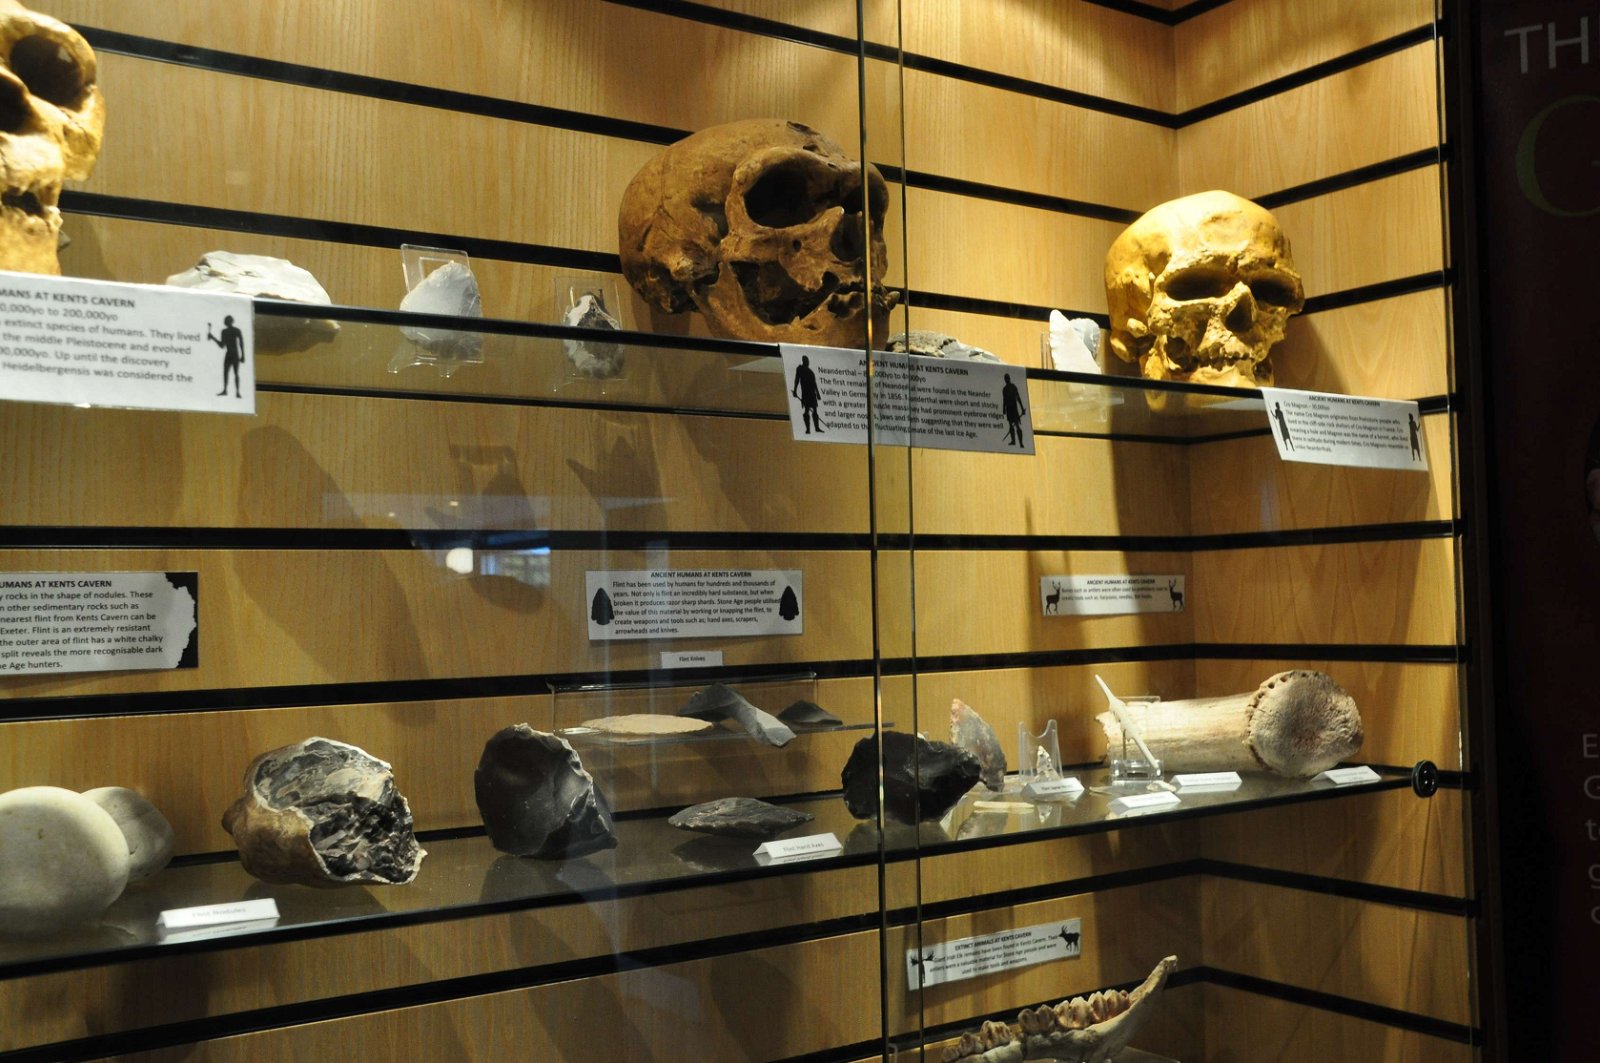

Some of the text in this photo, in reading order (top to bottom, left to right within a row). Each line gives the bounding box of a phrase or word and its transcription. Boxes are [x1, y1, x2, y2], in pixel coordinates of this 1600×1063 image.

[35, 292, 48, 301] AT
[53, 294, 88, 304] KENTS
[90, 297, 135, 308] CAVERN
[48, 306, 59, 315] to
[62, 308, 118, 322] 200,000yo
[4, 318, 200, 341] extinct species of humans. They lived
[2, 332, 191, 354] the middle Pleistocene and evolved
[54, 351, 70, 361] Up
[74, 353, 98, 361] until
[100, 354, 118, 363] the
[121, 355, 169, 368] discovery
[2, 361, 90, 375] Heidelbergensis
[116, 371, 173, 381] considered
[176, 374, 193, 382] the
[818, 367, 856, 376] Neanderthal
[944, 367, 969, 375] CAVERN
[820, 377, 832, 385] The
[832, 378, 845, 386] first
[821, 388, 840, 398] Valley
[56, 592, 81, 600] shape
[32, 603, 85, 612] sedimentary
[74, 625, 114, 634] extremely
[116, 624, 152, 632] resistant
[138, 635, 164, 644] chalky
[1, 650, 19, 659] split
[93, 647, 144, 656] recognisable
[10, 662, 26, 670] Age
